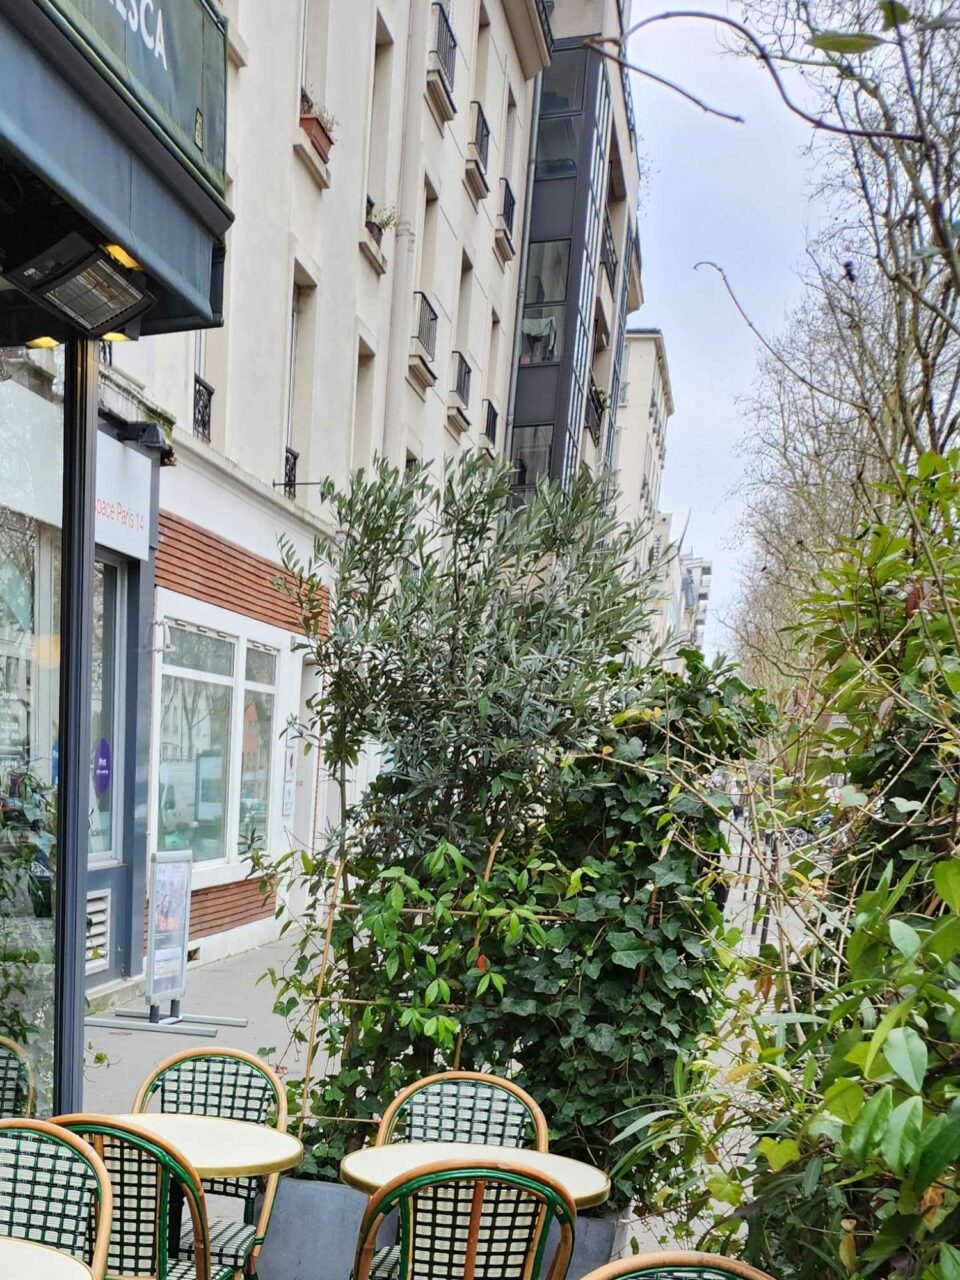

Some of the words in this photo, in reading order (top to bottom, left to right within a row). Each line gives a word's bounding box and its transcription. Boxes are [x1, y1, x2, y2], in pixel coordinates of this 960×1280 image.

[109, 0, 168, 72] SCA
[96, 498, 115, 520] pace
[116, 501, 135, 529] Paris
[137, 513, 145, 533] 14
